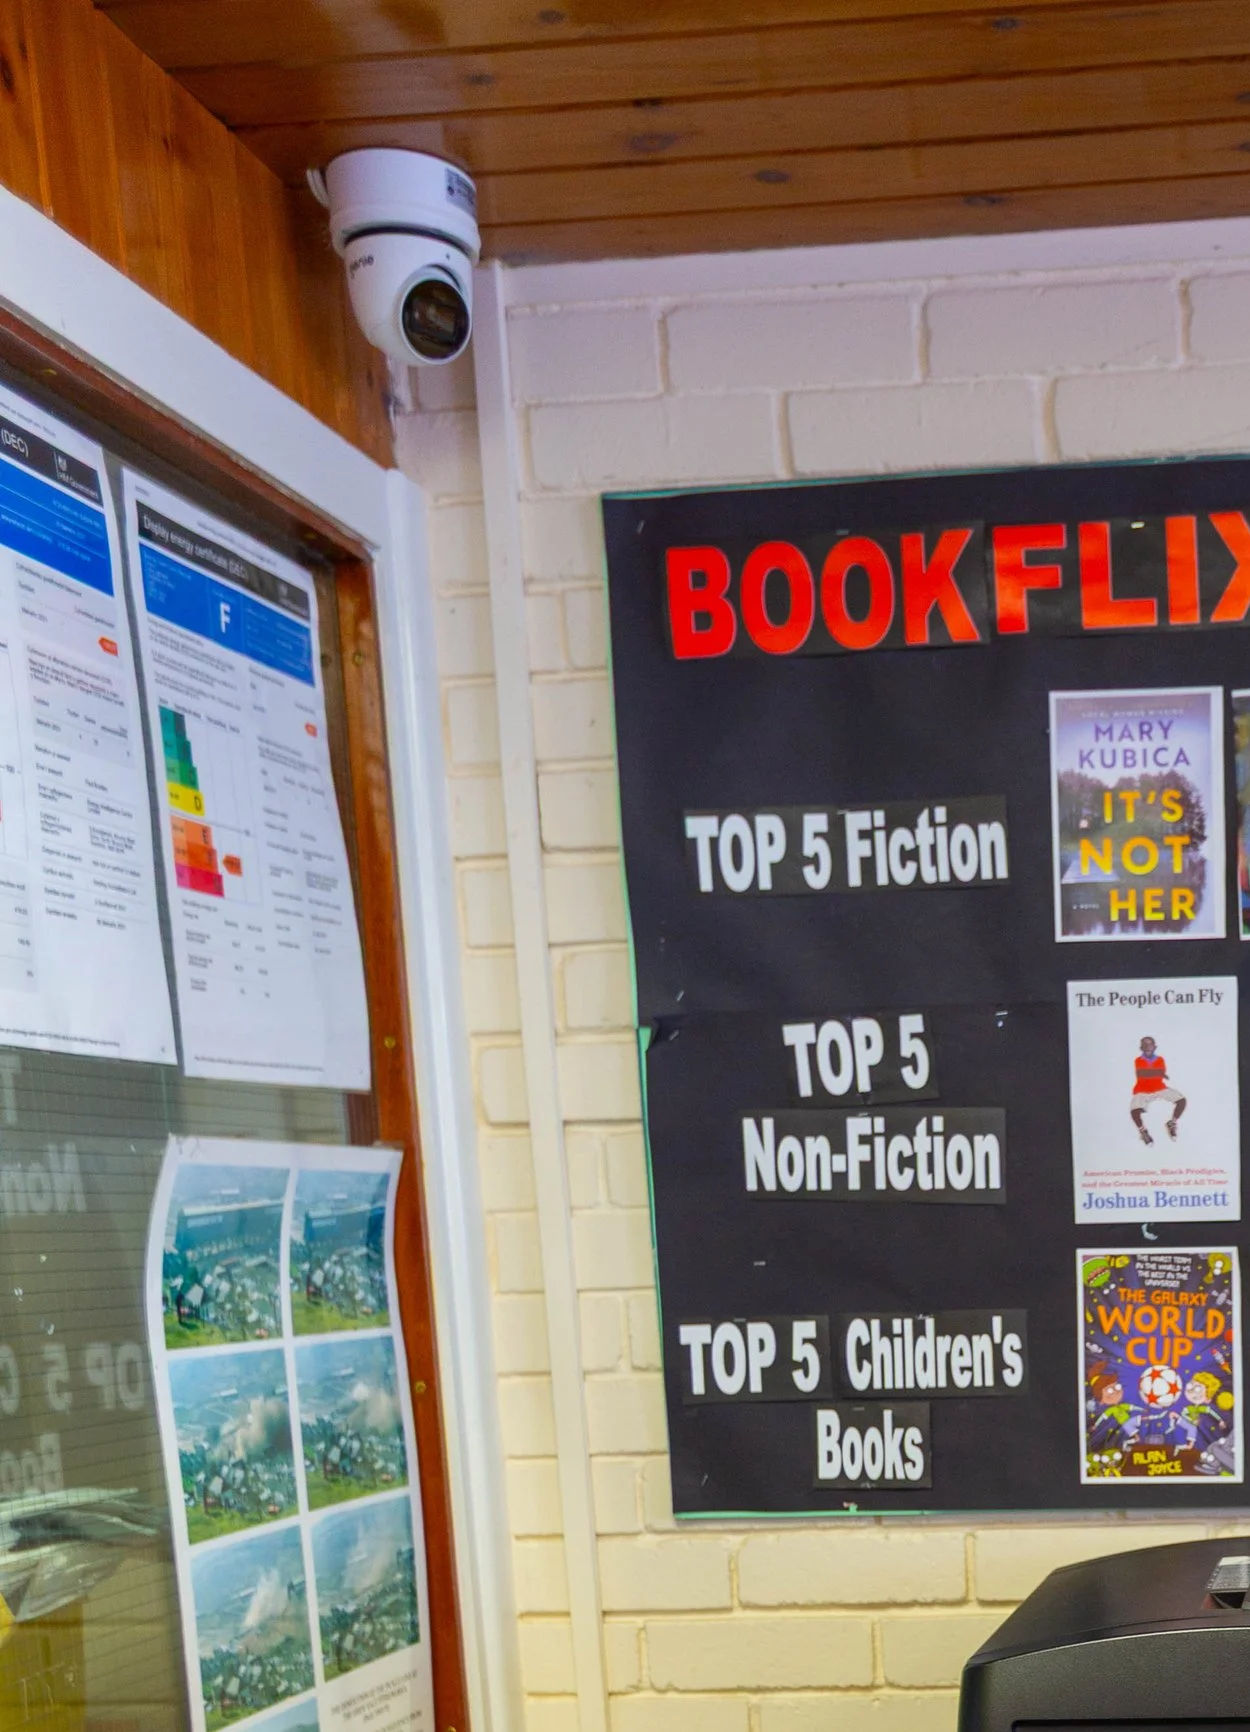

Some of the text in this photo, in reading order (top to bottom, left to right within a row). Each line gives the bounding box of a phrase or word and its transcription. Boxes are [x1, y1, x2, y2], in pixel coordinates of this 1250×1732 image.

[1, 428, 29, 458] (DEC)
[143, 515, 169, 543] Display
[170, 528, 195, 557] energy
[195, 544, 229, 571] certificate
[219, 602, 232, 634] F
[1094, 719, 1174, 743] MARY
[1079, 748, 1191, 770] KUBICA
[1104, 789, 1184, 823] IT'S
[686, 806, 1008, 892] TOP 5 Fiction
[1079, 834, 1191, 876] NOT
[1109, 888, 1196, 922] HER
[1076, 988, 1223, 1009] The People Can Fly
[782, 1014, 930, 1098] TOP 5
[742, 1115, 1002, 1192] Non-Fiction
[1083, 1191, 1229, 1210] Joshua Bennett
[1118, 1287, 1208, 1307] THE GALAXY
[1096, 1304, 1226, 1339] WORLD
[679, 1316, 1024, 1395] TOP 5 Children's
[1125, 1336, 1194, 1369] CUP
[816, 1408, 924, 1481] Books
[1133, 1450, 1167, 1465] ALAN
[1148, 1460, 1183, 1476] JOYCE
